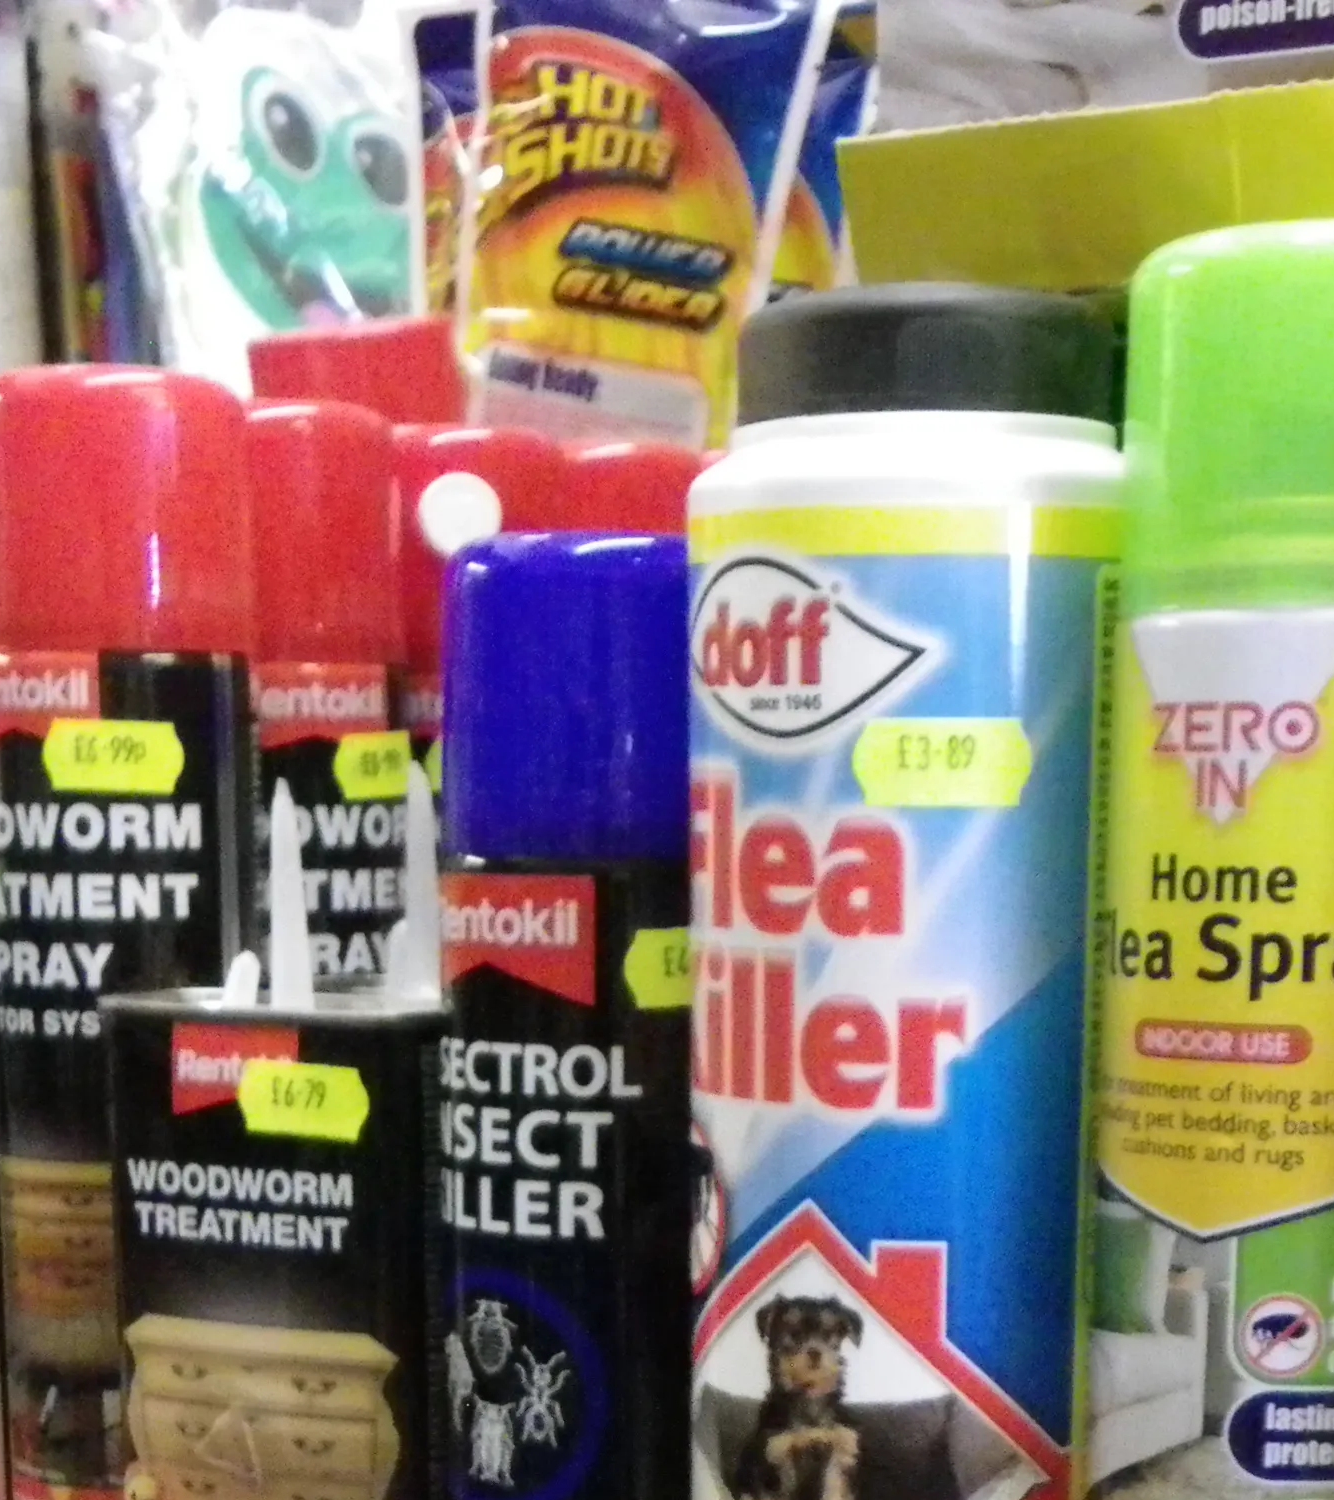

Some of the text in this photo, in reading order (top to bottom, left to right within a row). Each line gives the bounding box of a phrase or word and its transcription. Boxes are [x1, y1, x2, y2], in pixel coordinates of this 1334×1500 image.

[536, 63, 652, 126] HOT
[501, 122, 674, 200] SHOTS
[701, 596, 831, 688] doff
[1151, 700, 1321, 755] ZERO
[1194, 757, 1248, 809] IN
[1150, 852, 1299, 902] Home
[1103, 907, 1175, 982] lea
[691, 944, 969, 1111] iller
[1241, 1031, 1292, 1058] USE
[1208, 1081, 1234, 1103] of
[1239, 1083, 1303, 1112] living
[1144, 1108, 1176, 1132] pet
[1181, 1110, 1277, 1142] bedding,
[126, 1157, 354, 1210] WOODWORM
[1204, 1142, 1247, 1164] and
[1253, 1148, 1306, 1172] rugs
[133, 1200, 351, 1255] TREATMENT
